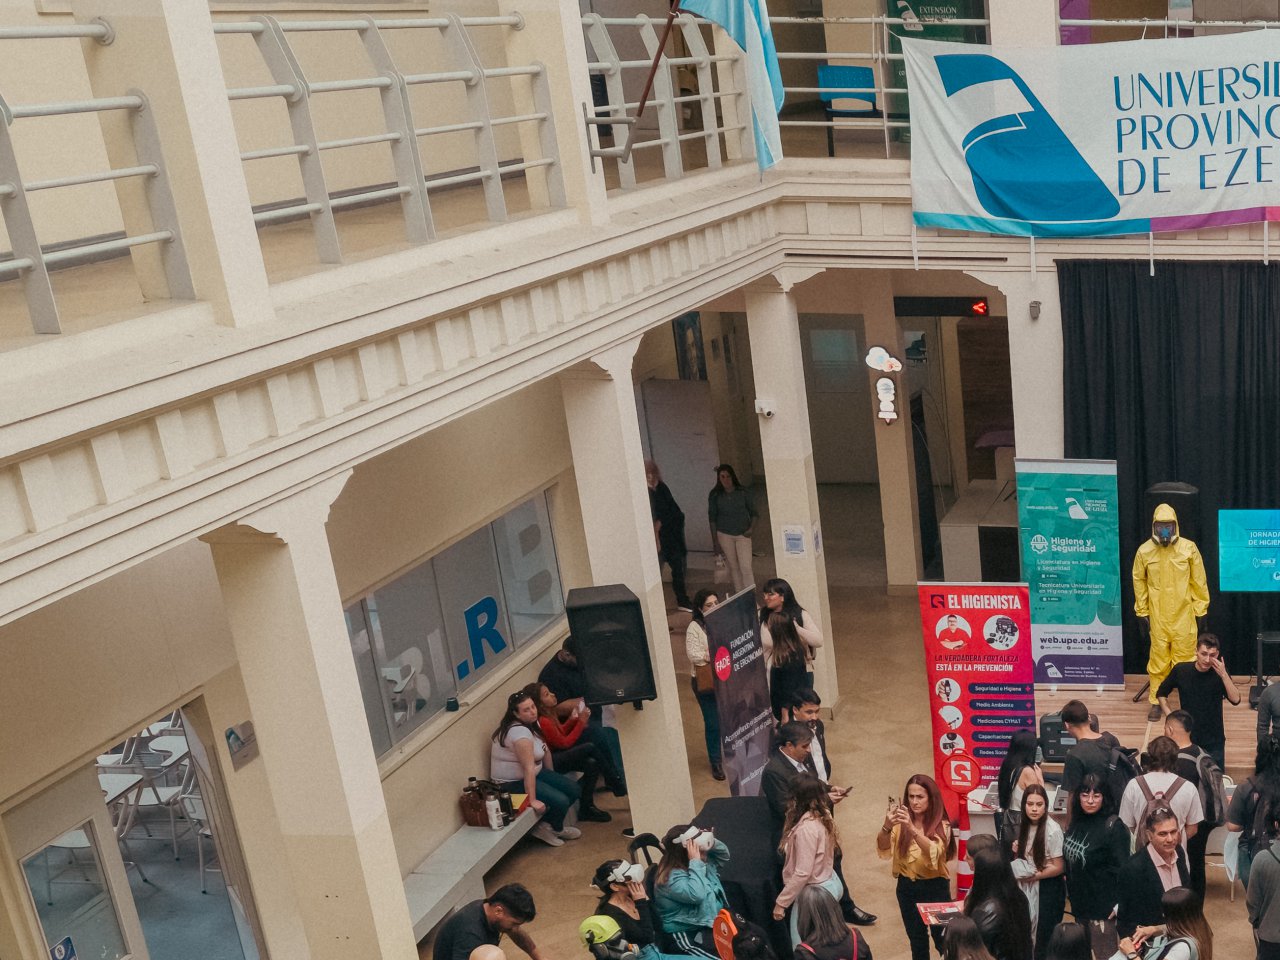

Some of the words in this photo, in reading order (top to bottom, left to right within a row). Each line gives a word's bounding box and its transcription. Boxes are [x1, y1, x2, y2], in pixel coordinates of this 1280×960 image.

[1117, 156, 1171, 196] DE
[1050, 537, 1084, 545] Higiene
[1051, 545, 1096, 553] Seguridad
[947, 594, 960, 609] EL
[961, 594, 1021, 609] HIGIENISTA
[730, 629, 754, 650] FUNDACIÓN
[1040, 637, 1109, 646] web.upe.edu.ar
[732, 641, 755, 660] ARGENTINA
[715, 656, 731, 672] FADE
[983, 654, 1019, 662] FORTALEZA
[935, 663, 952, 671] ESTÁ
[973, 663, 1013, 672] PREVENCIÓN
